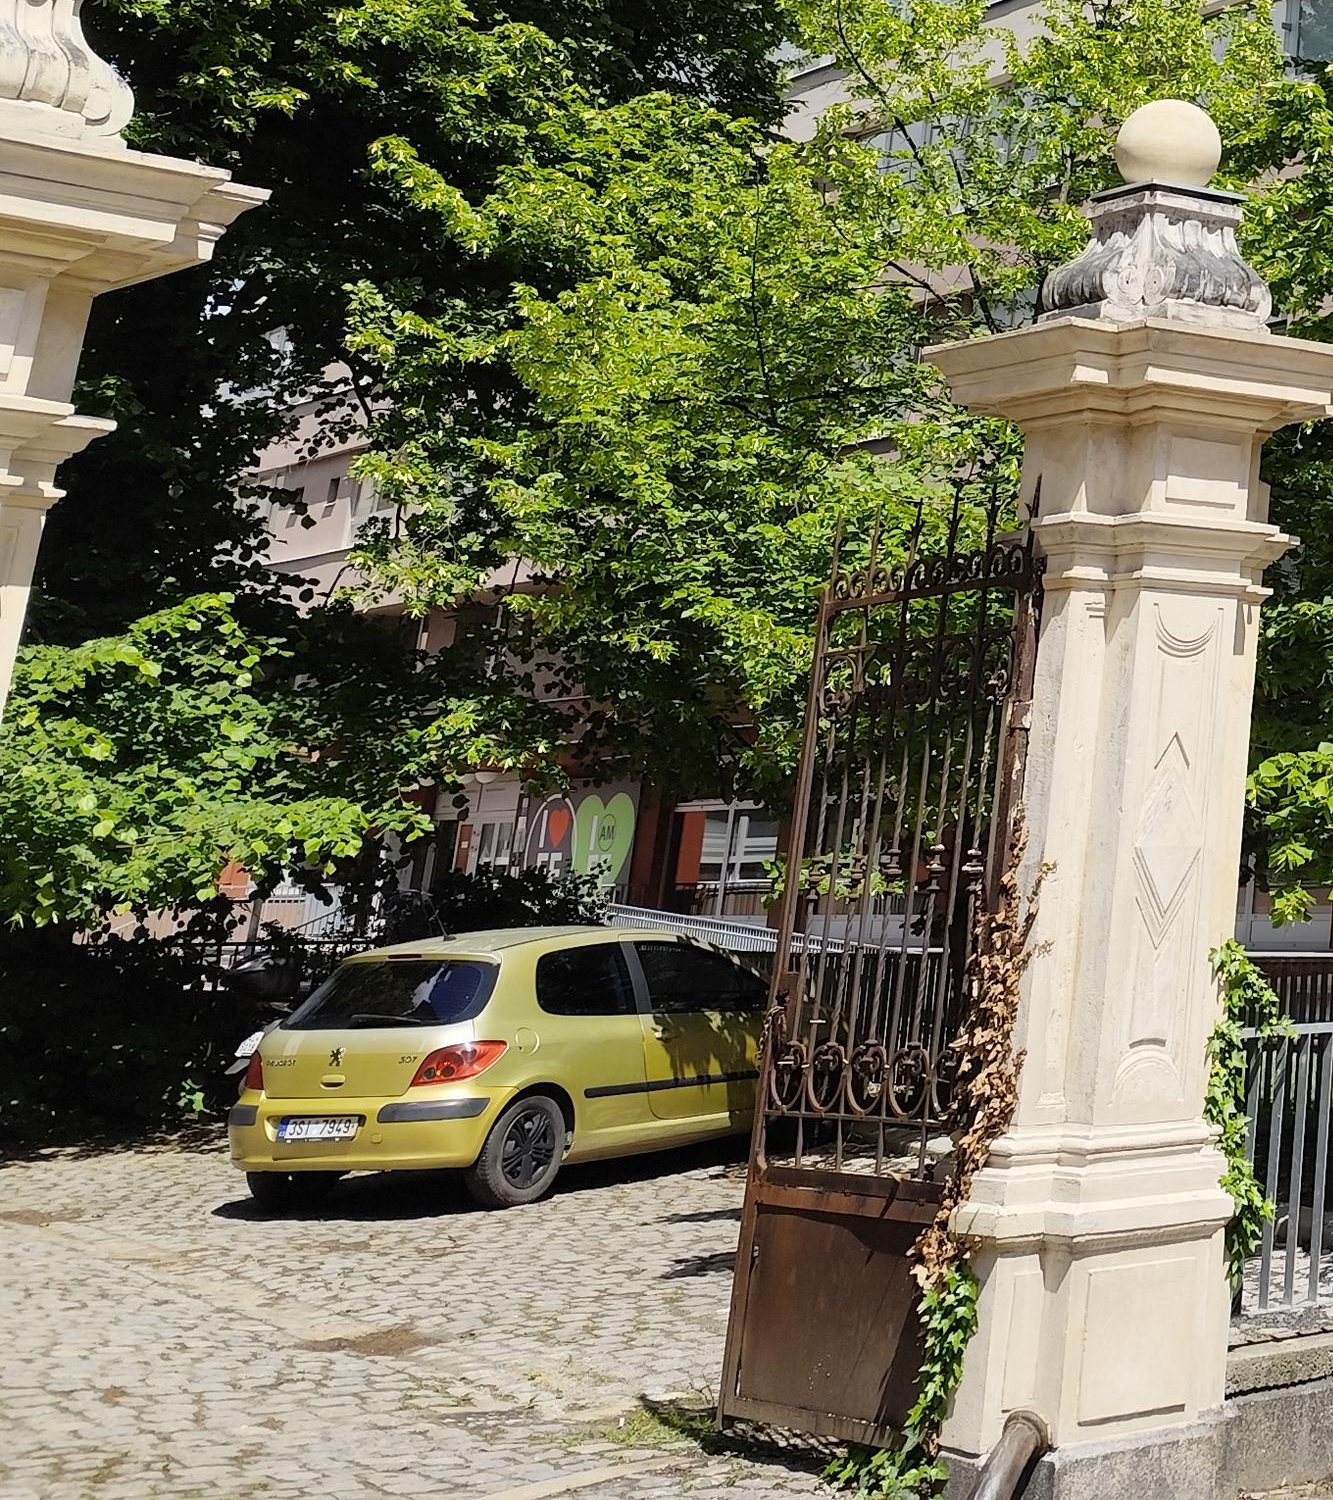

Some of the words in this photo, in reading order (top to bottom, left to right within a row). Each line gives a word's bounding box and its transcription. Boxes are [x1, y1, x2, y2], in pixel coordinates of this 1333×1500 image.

[600, 825, 615, 841] AM
[398, 1056, 417, 1064] 307
[320, 1119, 352, 1135] 7949
